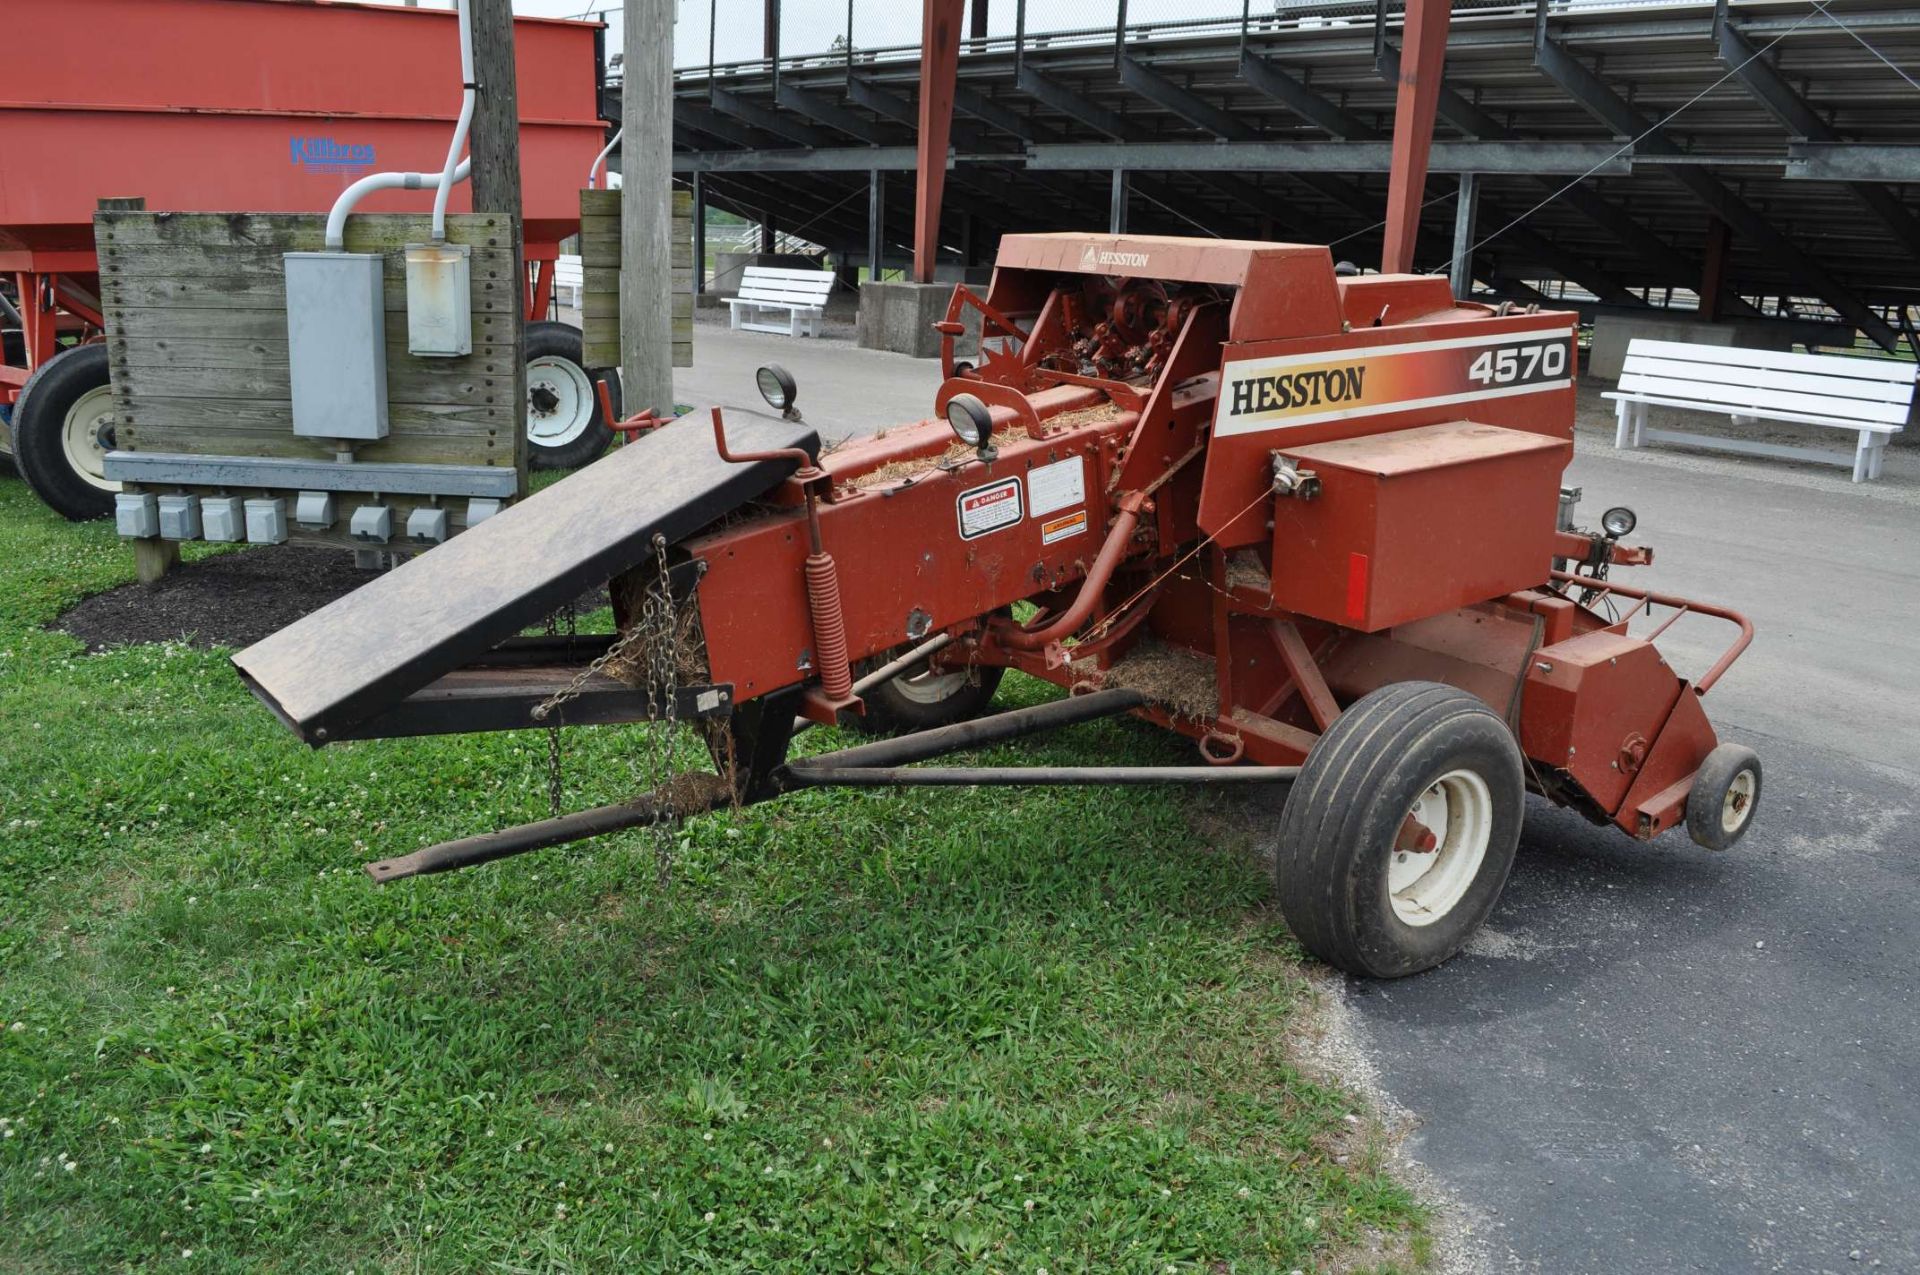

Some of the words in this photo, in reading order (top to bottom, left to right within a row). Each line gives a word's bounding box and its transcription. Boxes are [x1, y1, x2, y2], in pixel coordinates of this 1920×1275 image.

[290, 136, 376, 165] Killbros
[1099, 251, 1149, 267] HESSTON
[1468, 343, 1566, 385] 4570
[1230, 366, 1365, 416] HESSTON
[980, 490, 1008, 505] DANGER
